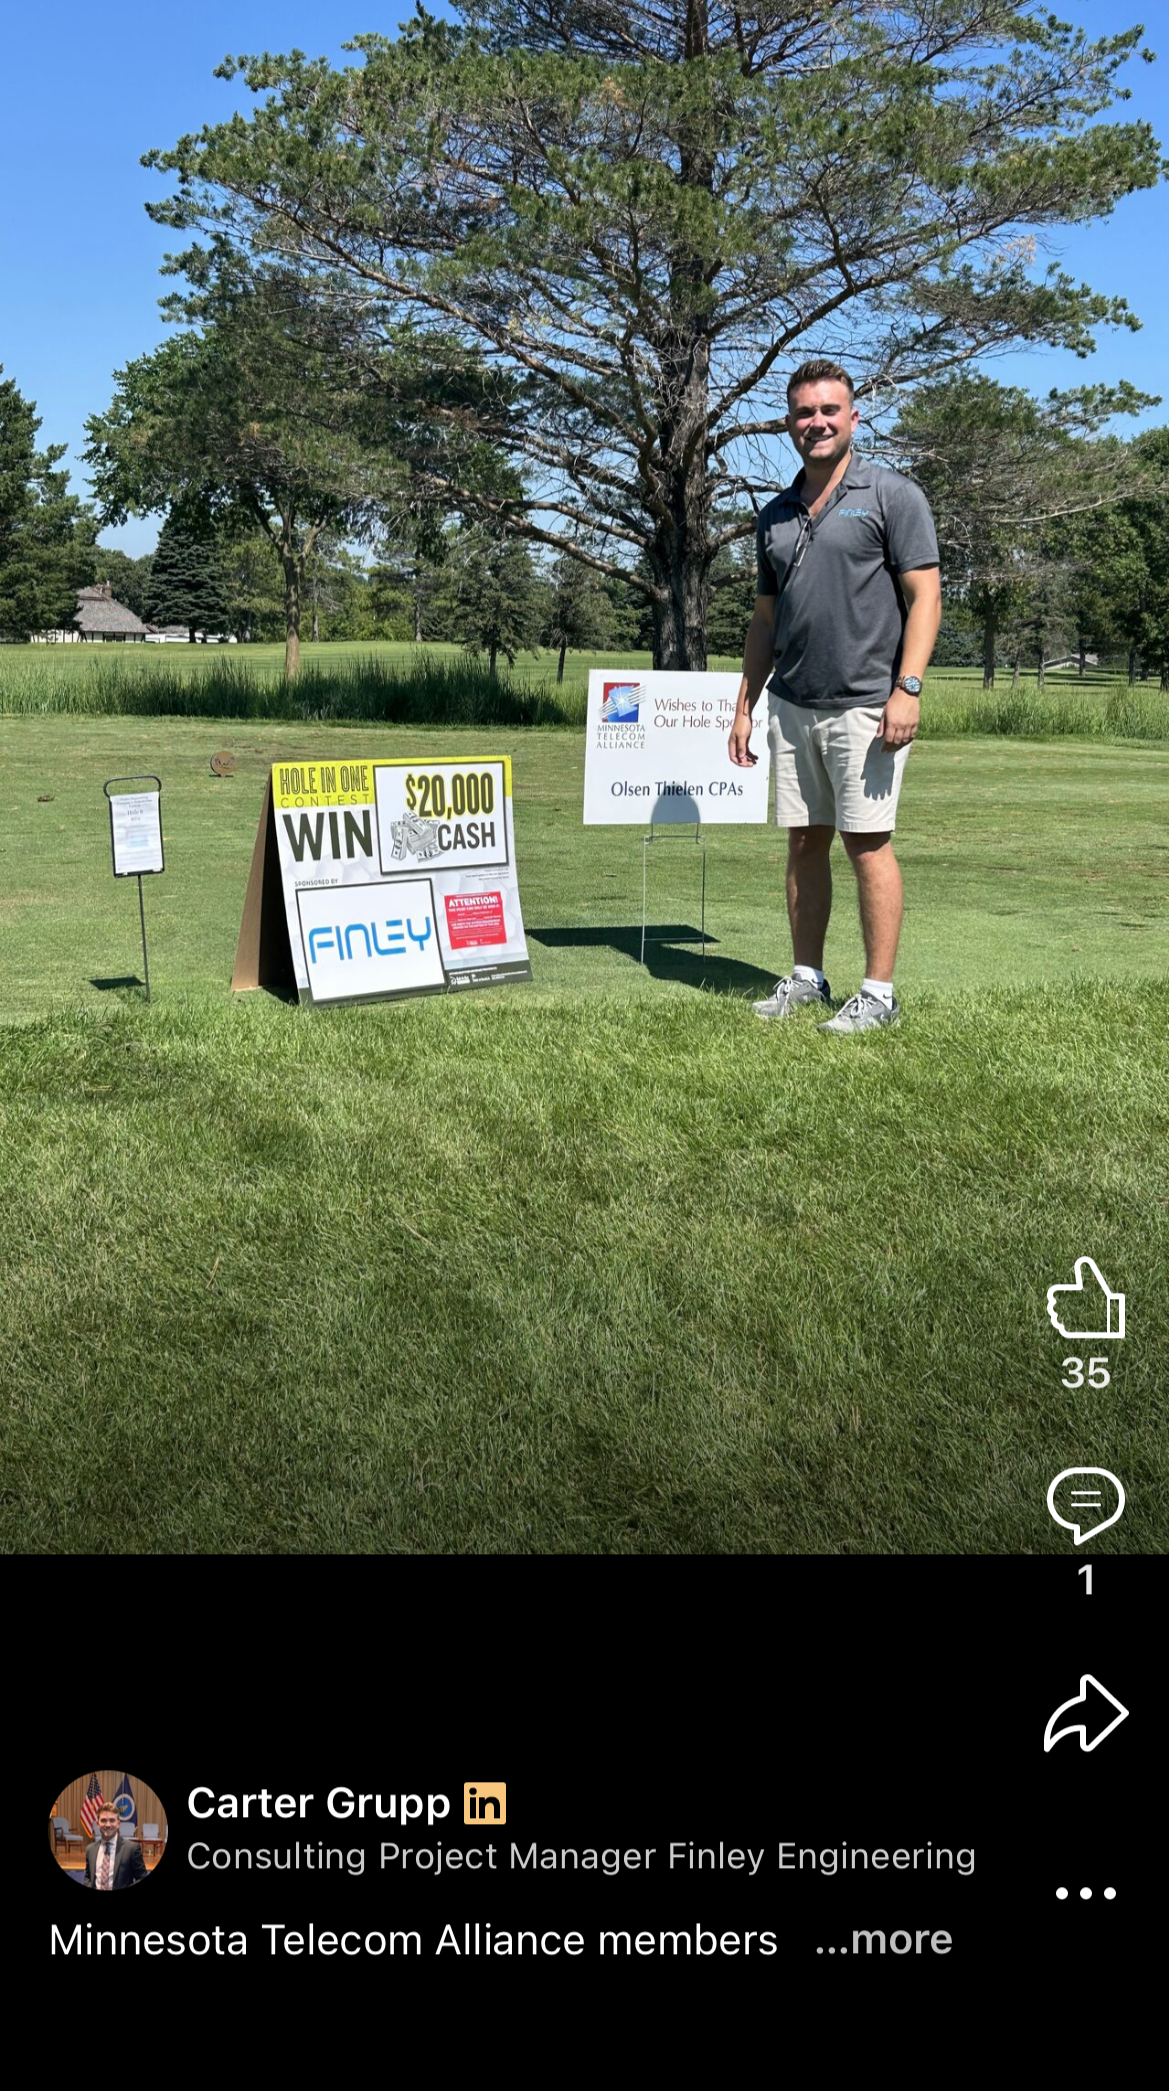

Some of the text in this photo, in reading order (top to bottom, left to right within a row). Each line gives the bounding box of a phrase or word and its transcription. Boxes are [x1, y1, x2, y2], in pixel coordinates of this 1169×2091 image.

[654, 698, 738, 712] Wishes to Tha
[597, 724, 646, 732] MINNESOTA
[653, 715, 679, 728] Our
[682, 715, 711, 728] Hole
[597, 733, 646, 741] TELECOM
[596, 741, 645, 749] ALLIANCE
[279, 765, 370, 795] HOLE IN ONE
[611, 780, 744, 797] Olsen Thielen CPAs
[280, 794, 370, 809] CONTEST
[405, 772, 495, 820] $20,000
[282, 809, 374, 862] WIN
[437, 821, 496, 851] CASH
[294, 879, 330, 887] SPONSORED
[448, 896, 498, 908] ATTENTION!
[308, 916, 432, 964] FINLEY
